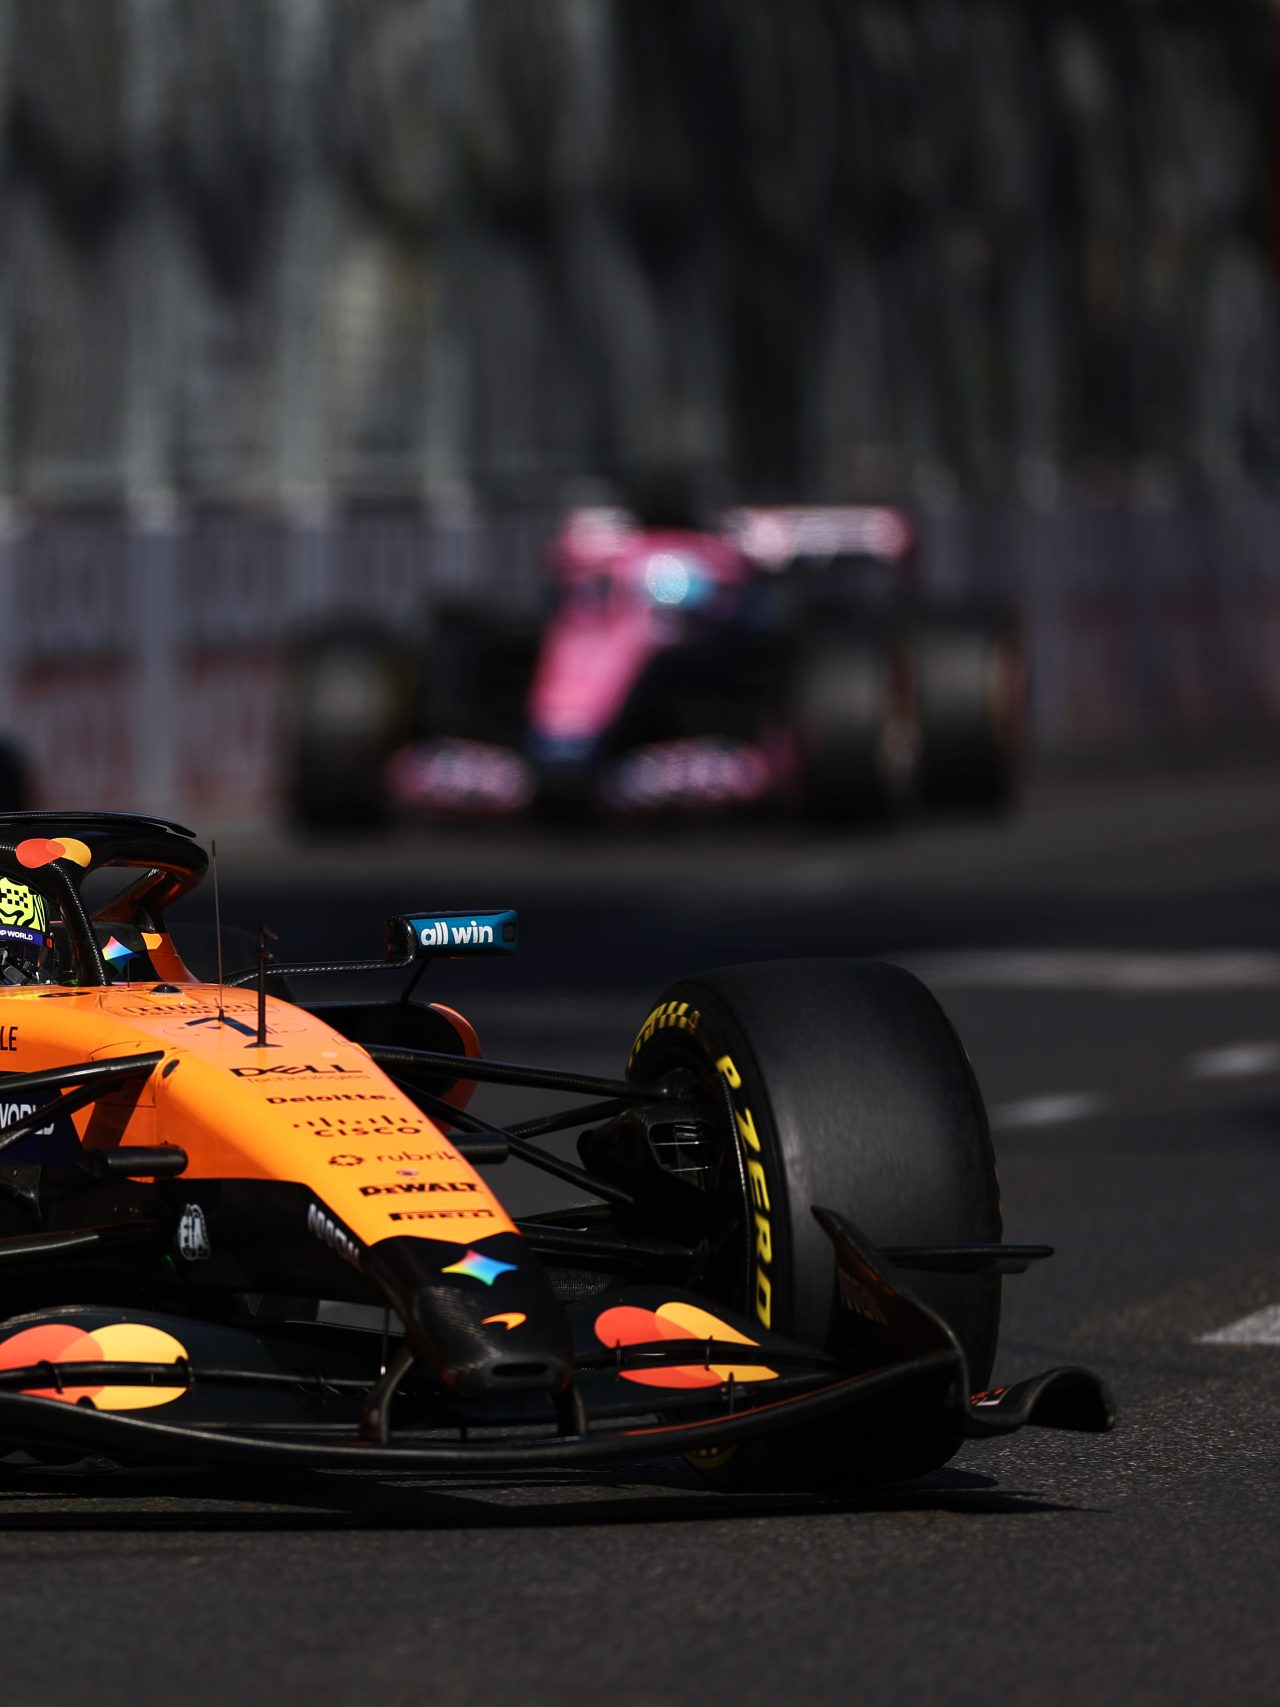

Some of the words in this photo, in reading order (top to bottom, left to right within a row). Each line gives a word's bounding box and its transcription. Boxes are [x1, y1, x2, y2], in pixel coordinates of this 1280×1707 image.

[7, 931, 33, 941] WORLD
[420, 922, 448, 946] all
[451, 920, 494, 944] win
[229, 1063, 363, 1078] DELL
[375, 1151, 458, 1162] rubrik
